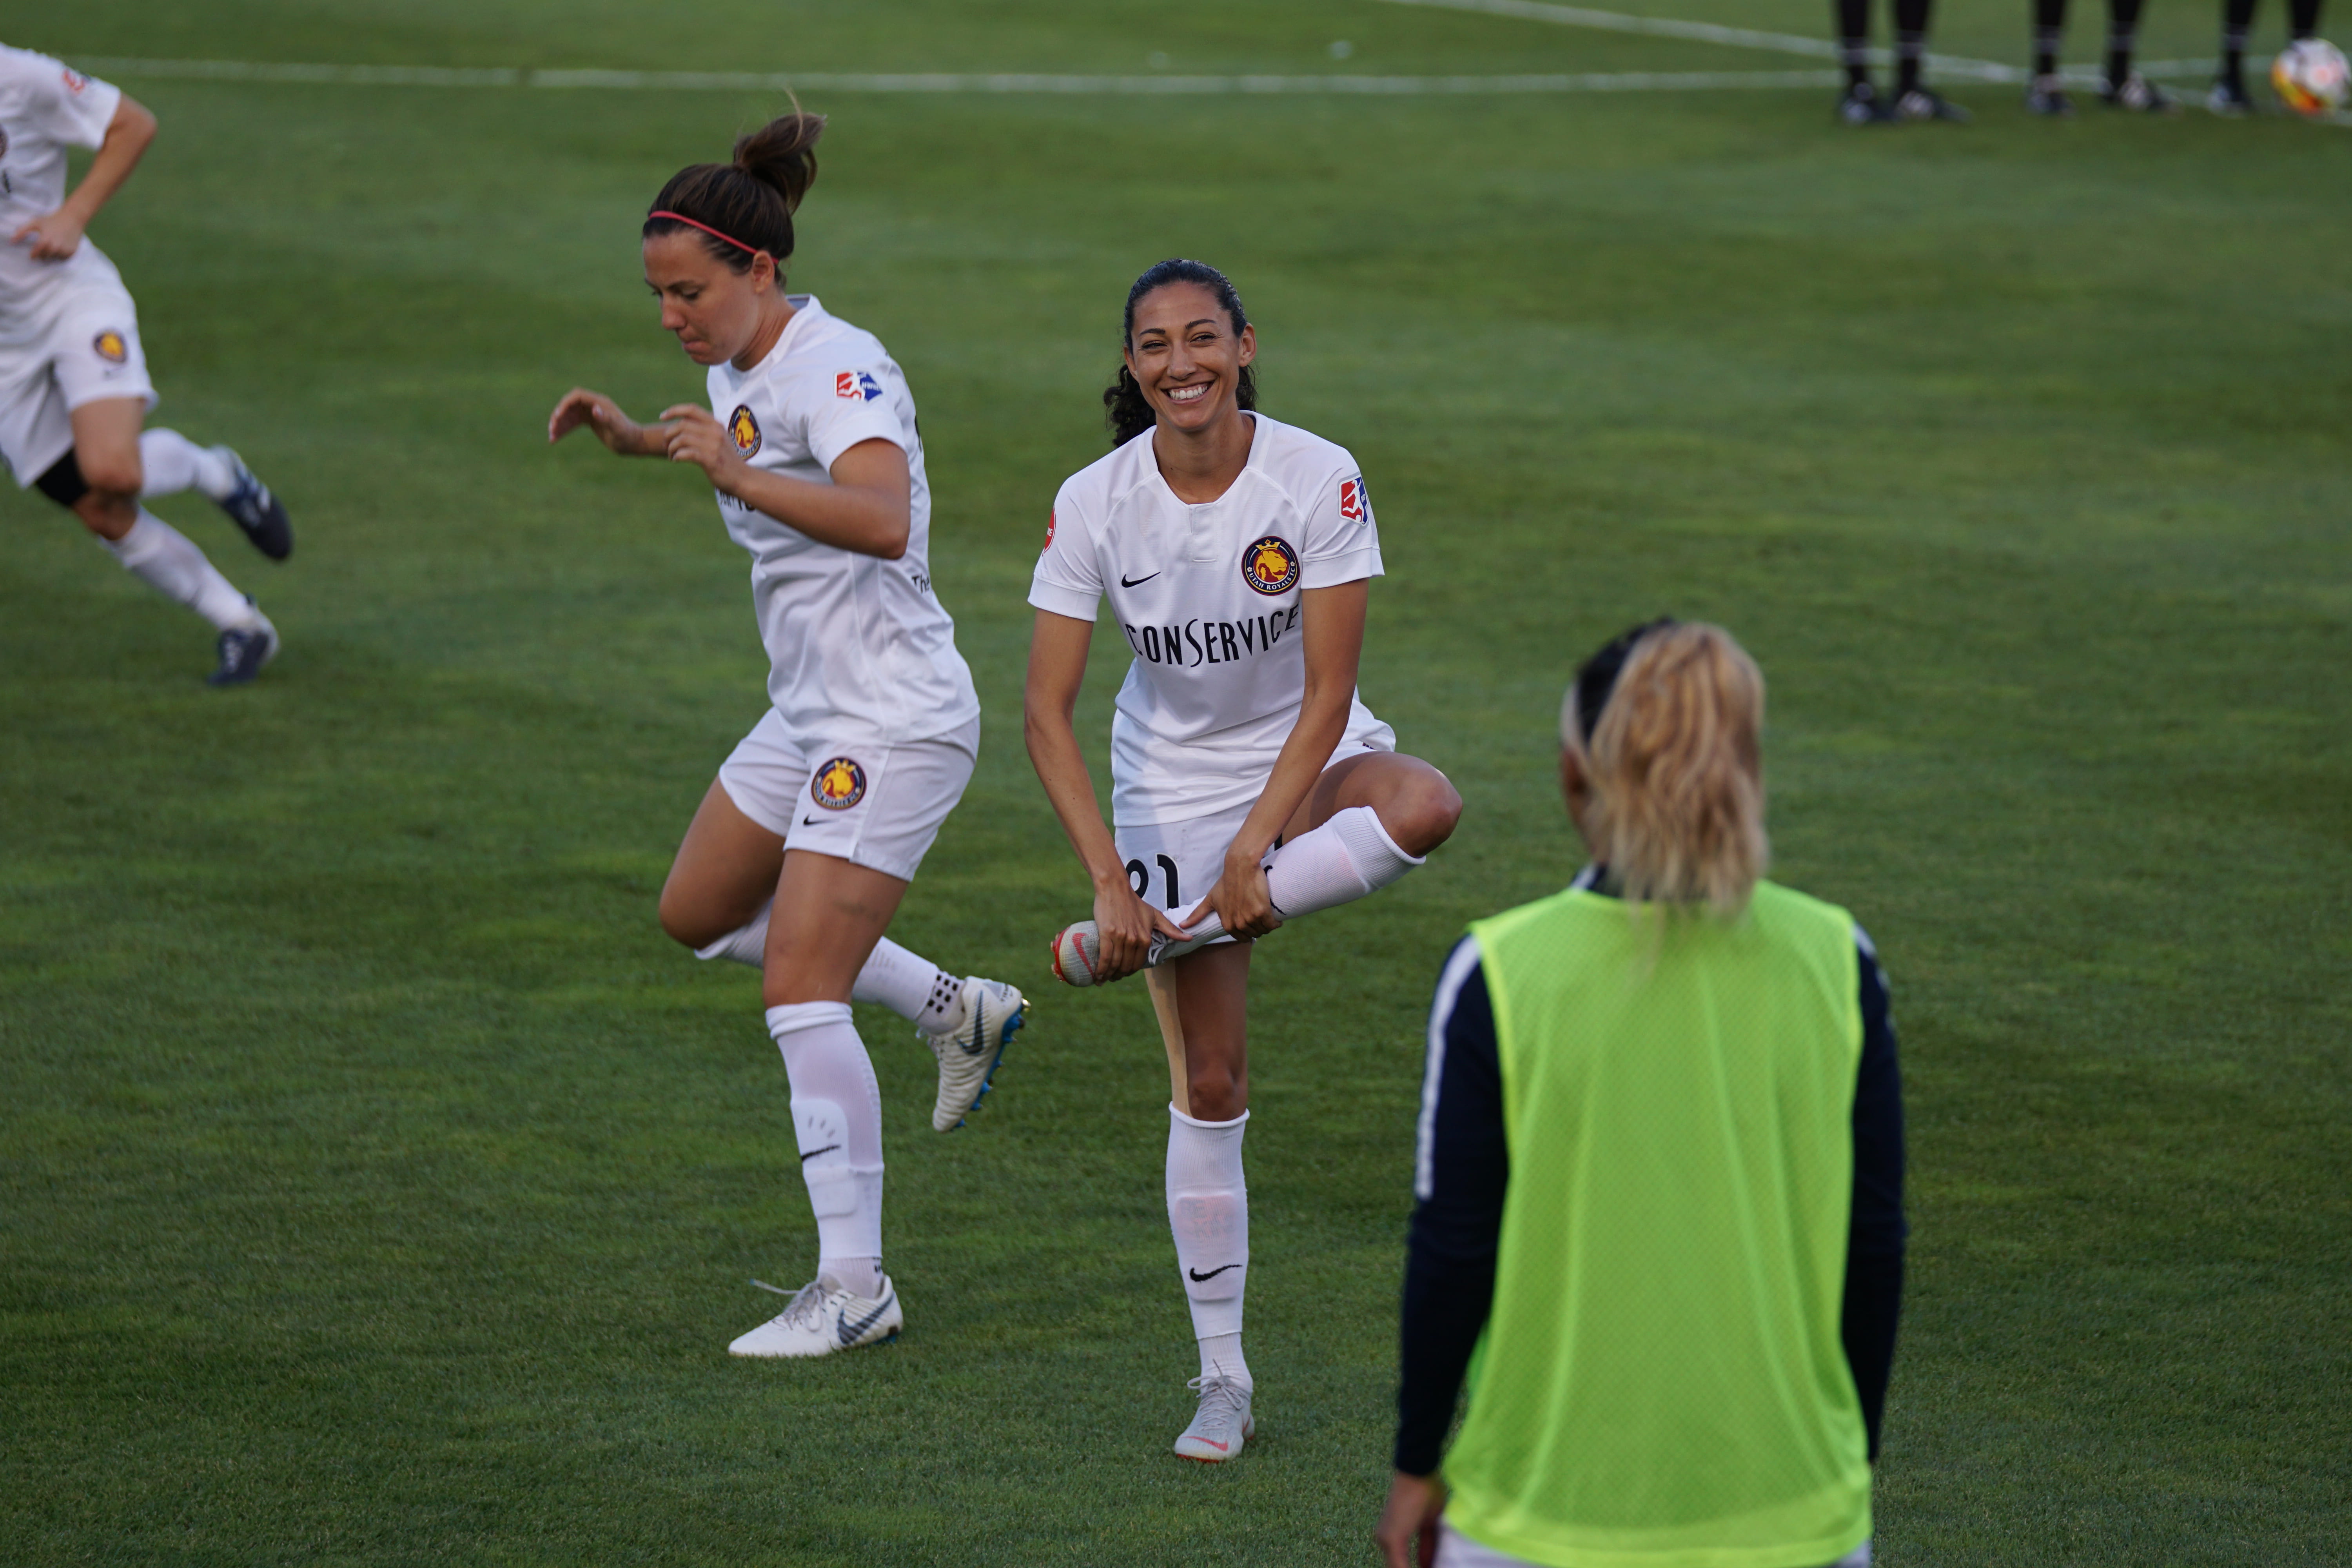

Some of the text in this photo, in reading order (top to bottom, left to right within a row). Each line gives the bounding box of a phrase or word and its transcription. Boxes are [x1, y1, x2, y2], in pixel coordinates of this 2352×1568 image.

[1249, 568, 1295, 590] UTAH ROYALS FC
[1125, 603, 1299, 668] CONSERVICE
